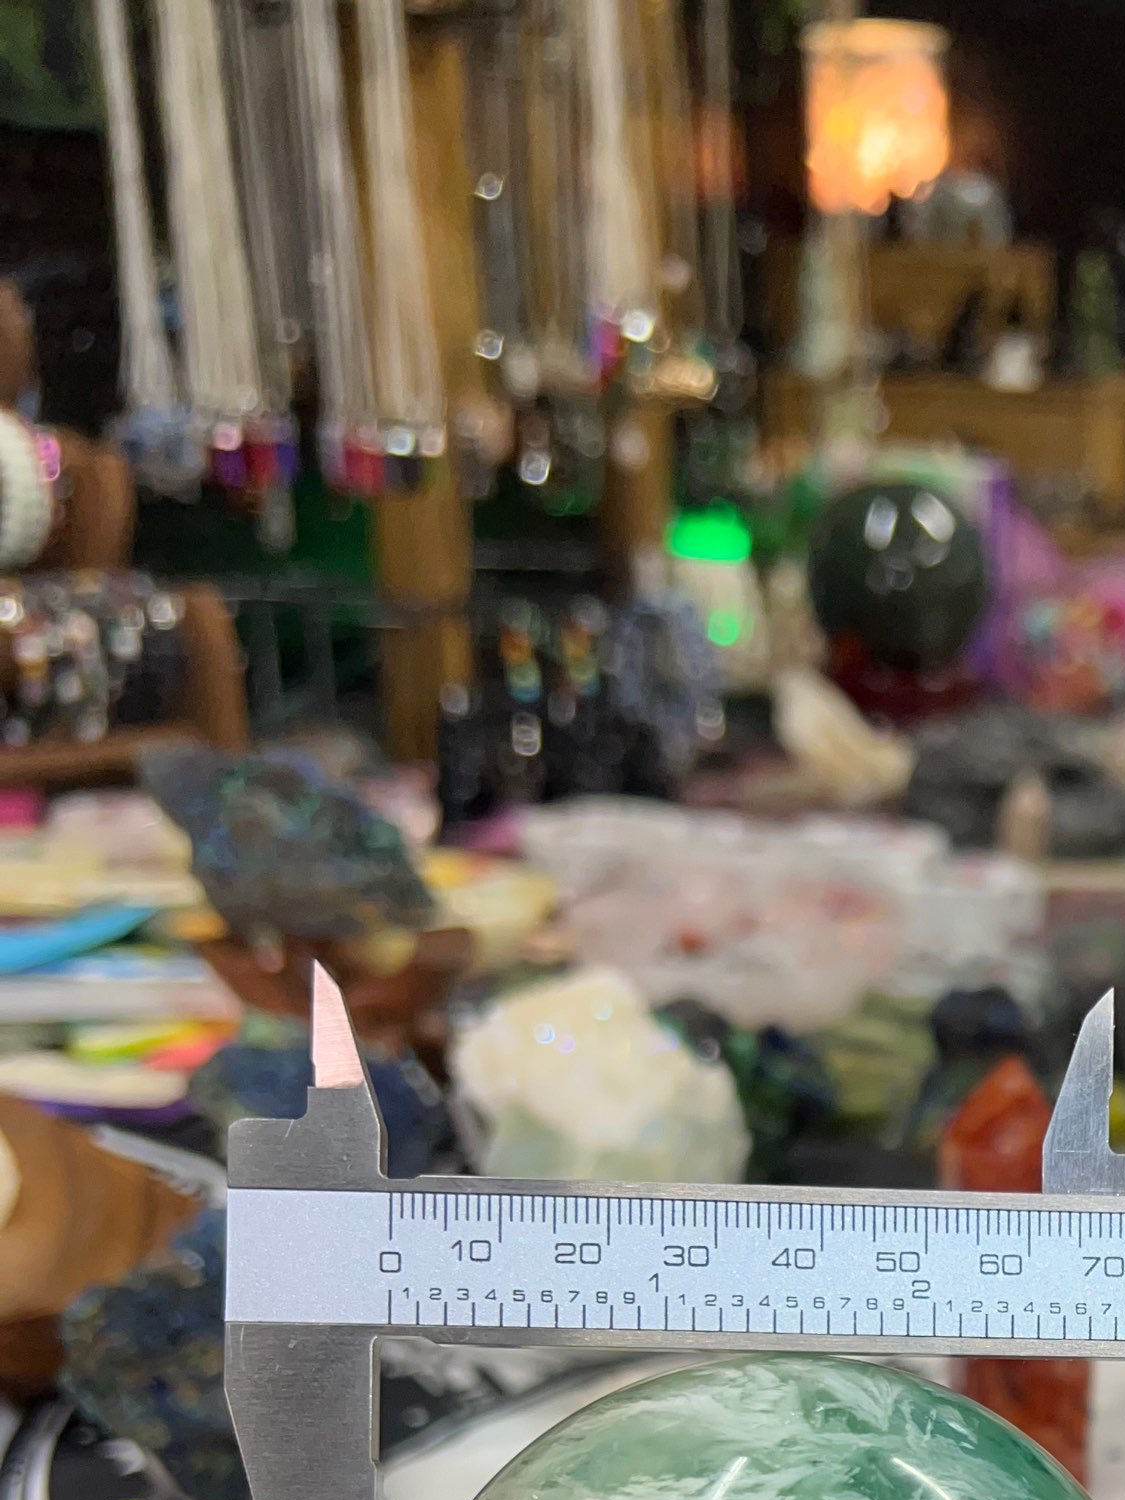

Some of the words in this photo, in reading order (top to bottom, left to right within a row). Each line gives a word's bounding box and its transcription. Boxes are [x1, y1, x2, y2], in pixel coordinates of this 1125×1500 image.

[378, 1250, 402, 1274] 0
[450, 1239, 492, 1264] 10
[554, 1242, 602, 1265] 20
[662, 1244, 710, 1268] 30
[770, 1247, 816, 1271] 40
[875, 1250, 921, 1274] 50
[978, 1253, 1023, 1277] 60
[1081, 1255, 1125, 1279] 70
[401, 1286, 410, 1300] 1
[429, 1287, 442, 1301] 2
[456, 1287, 470, 1302] 3
[485, 1288, 498, 1302] 4
[513, 1289, 526, 1303] 5
[541, 1289, 554, 1304] 6
[568, 1290, 581, 1304] 7
[596, 1290, 608, 1305] 8
[623, 1291, 636, 1305] 9
[647, 1272, 660, 1294] 1
[677, 1293, 686, 1306] 1
[704, 1293, 717, 1307] 2
[731, 1294, 744, 1308] 3
[758, 1294, 772, 1308] 4
[785, 1295, 798, 1309] 5
[812, 1296, 826, 1310] 6
[839, 1296, 852, 1310] 7
[866, 1297, 878, 1311] 8
[892, 1297, 905, 1311] 9
[911, 1279, 932, 1300] 2
[944, 1299, 953, 1313] 1
[970, 1300, 983, 1314] 2
[997, 1300, 1010, 1314] 3
[1022, 1301, 1035, 1314] 4
[1049, 1301, 1062, 1315] 5
[1075, 1302, 1088, 1316] 6
[1101, 1303, 1113, 1316] 7
